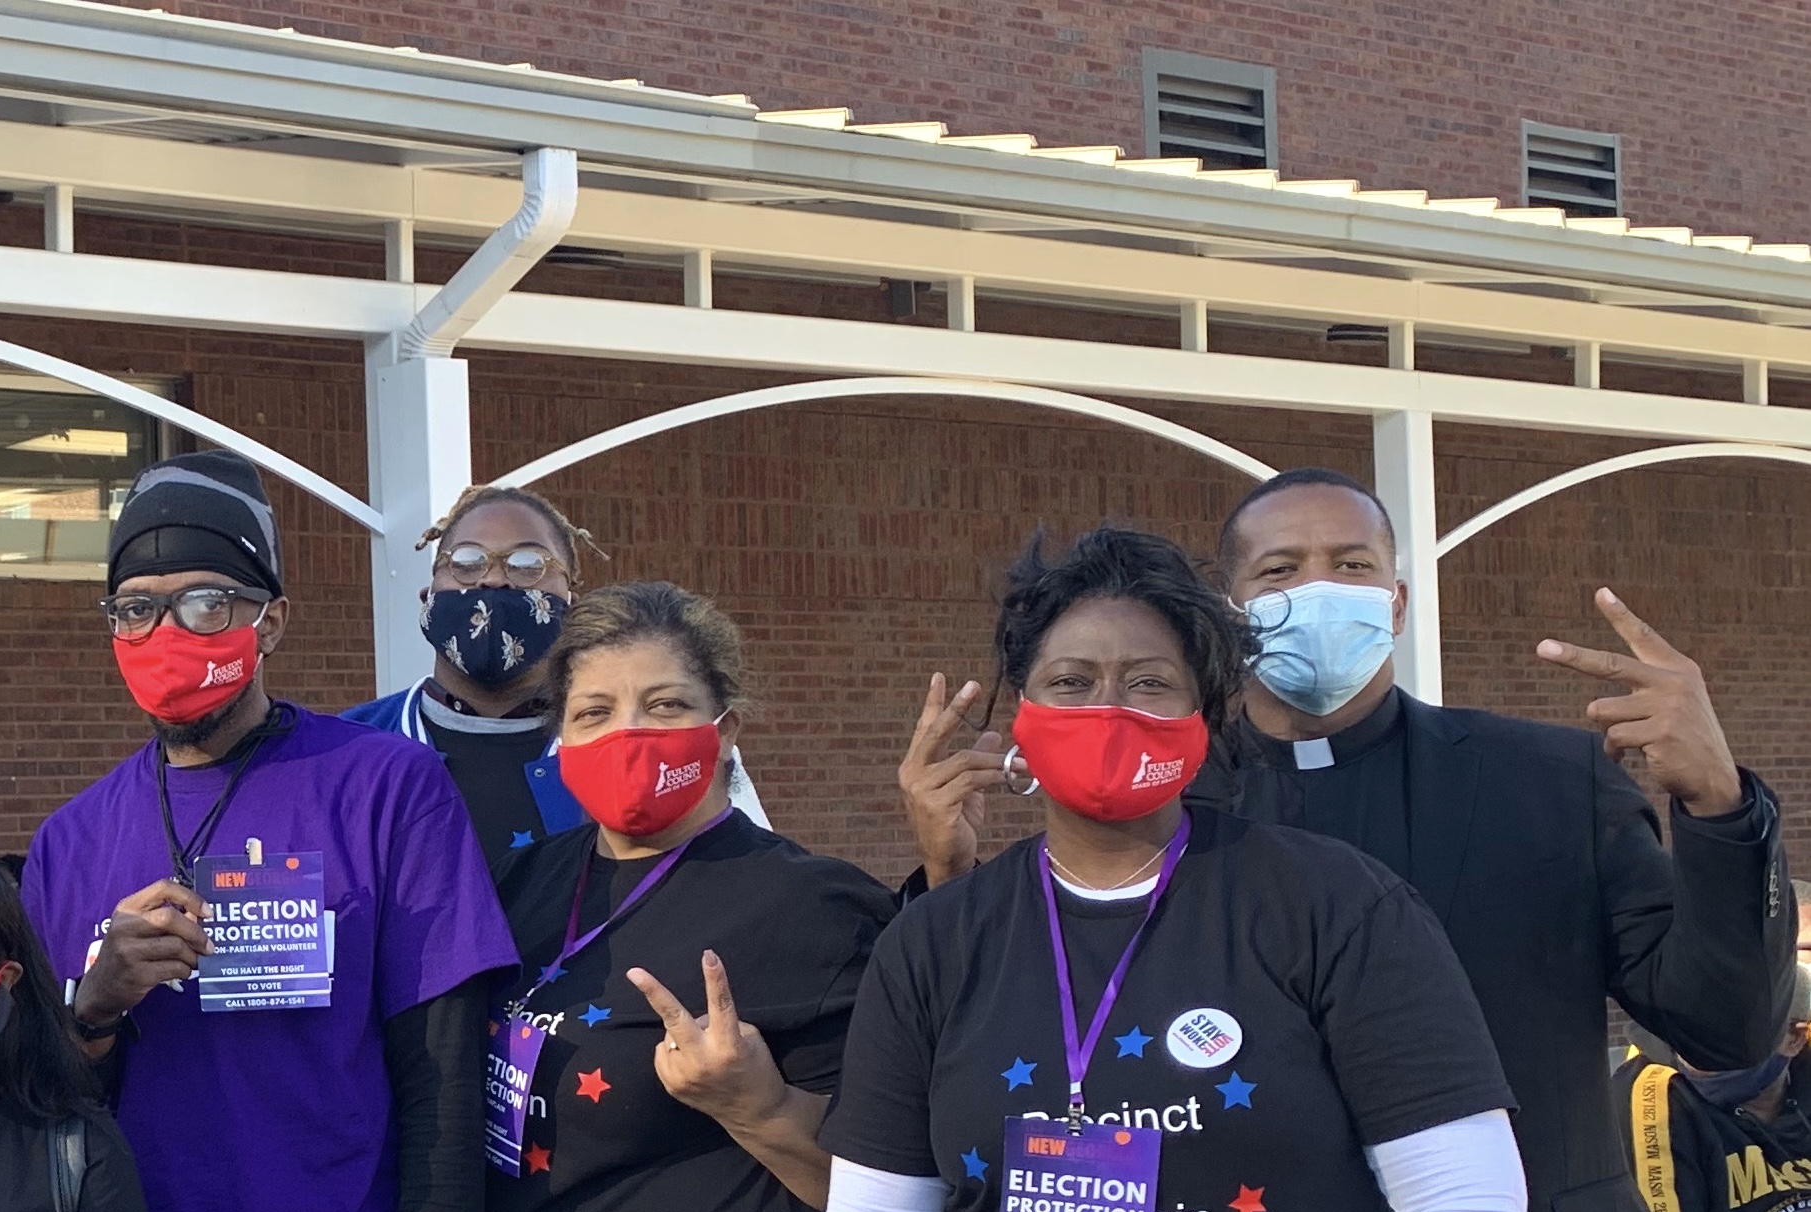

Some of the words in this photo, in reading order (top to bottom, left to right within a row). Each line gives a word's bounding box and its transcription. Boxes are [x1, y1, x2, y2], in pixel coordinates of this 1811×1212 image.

[665, 760, 700, 778] FULTON
[1147, 757, 1184, 773] FULTON
[1146, 767, 1183, 782] COUNTY
[215, 872, 246, 888] NEW
[203, 922, 319, 942] PROTECTION
[214, 944, 269, 954] ON-PARTISAN
[270, 942, 318, 952] VOLUNTEER
[221, 966, 239, 976] YOU
[240, 966, 262, 975] HAVE
[263, 965, 279, 975] THE
[280, 964, 305, 974] RIGHT
[247, 982, 259, 991] TO
[260, 981, 282, 991] VOTE
[225, 999, 246, 1008] CALL
[247, 996, 306, 1008] 1800-874-1541
[1191, 1014, 1222, 1041] STAY
[1179, 1023, 1209, 1051] WOKE
[1027, 1137, 1066, 1156] NEW
[1643, 1125, 1660, 1159] MASON
[1008, 1168, 1147, 1205] ELECTION
